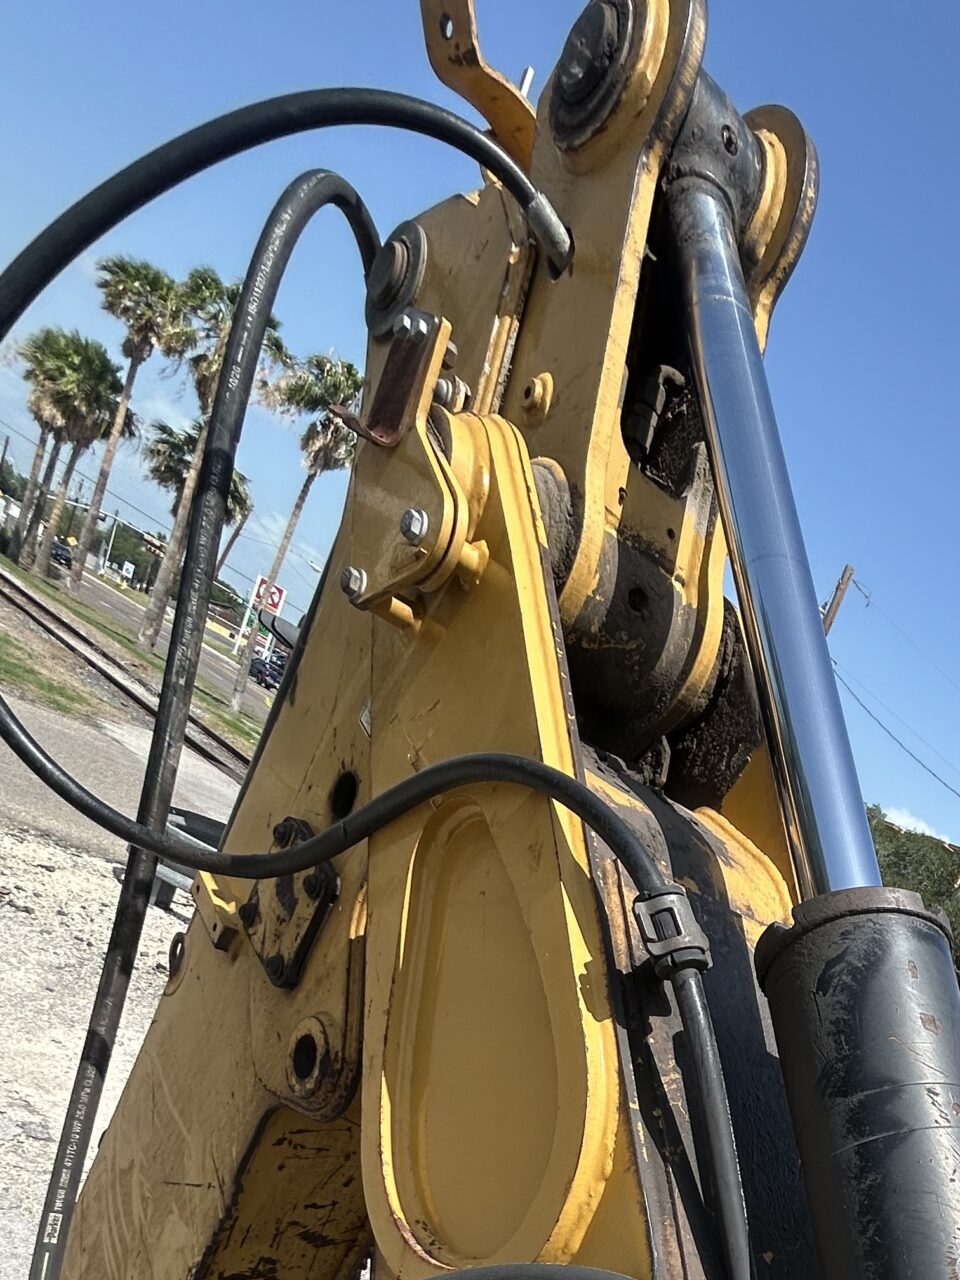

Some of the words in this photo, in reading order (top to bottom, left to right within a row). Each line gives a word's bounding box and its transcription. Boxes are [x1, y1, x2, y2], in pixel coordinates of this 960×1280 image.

[45, 1212, 61, 1241] Parker
[64, 1134, 80, 1167] 471TC-10
[72, 1118, 83, 1134] WP
